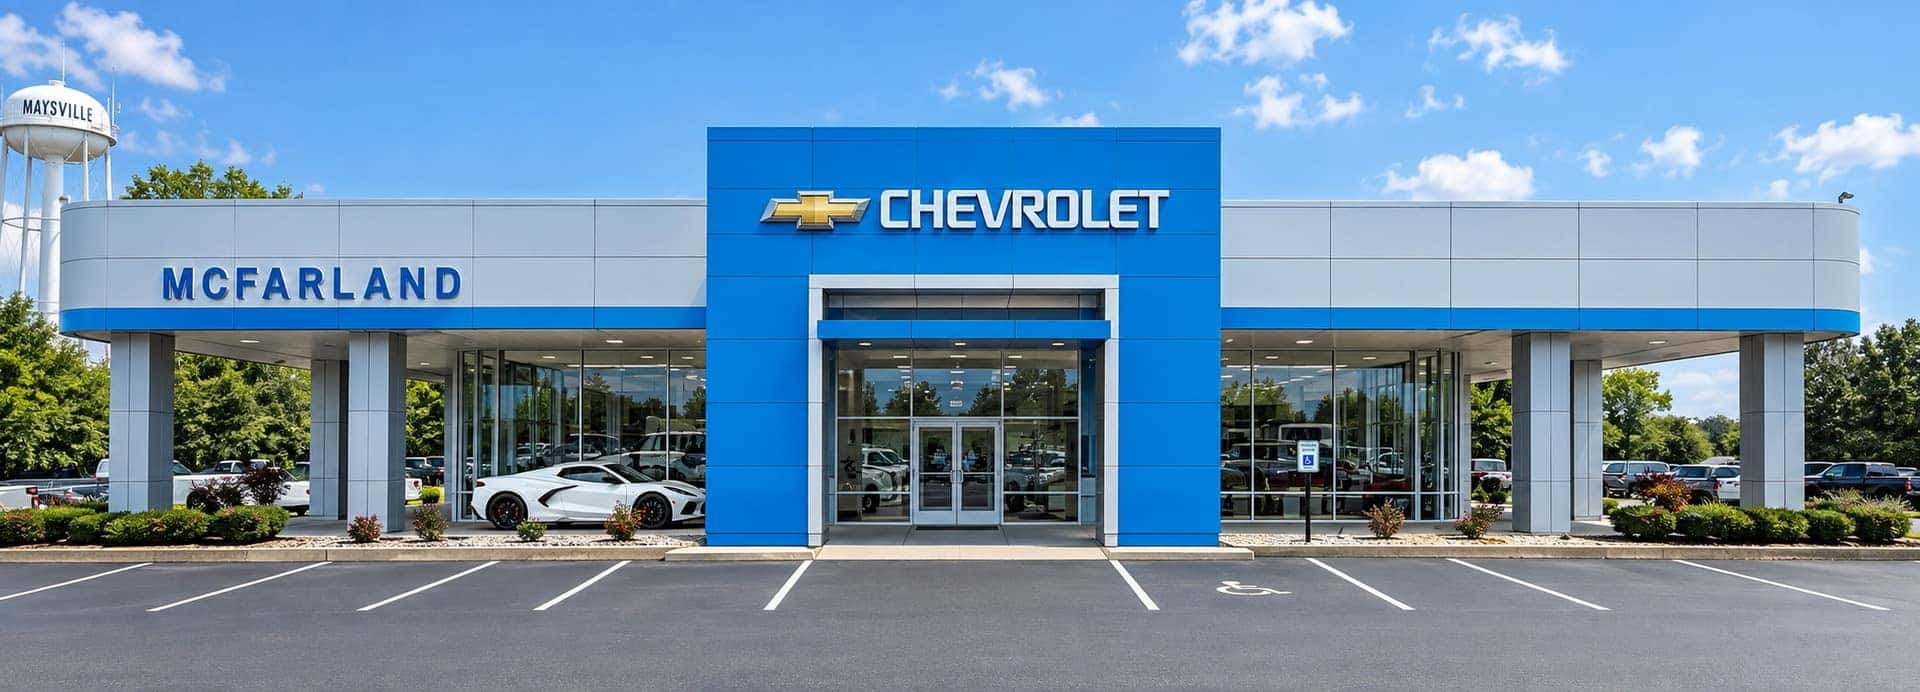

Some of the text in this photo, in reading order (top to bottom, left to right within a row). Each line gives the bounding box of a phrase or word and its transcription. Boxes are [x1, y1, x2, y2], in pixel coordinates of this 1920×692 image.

[23, 99, 93, 122] MAYSVILLE
[880, 189, 1170, 229] CHEVROLET
[161, 266, 462, 300] MCFARLAND
